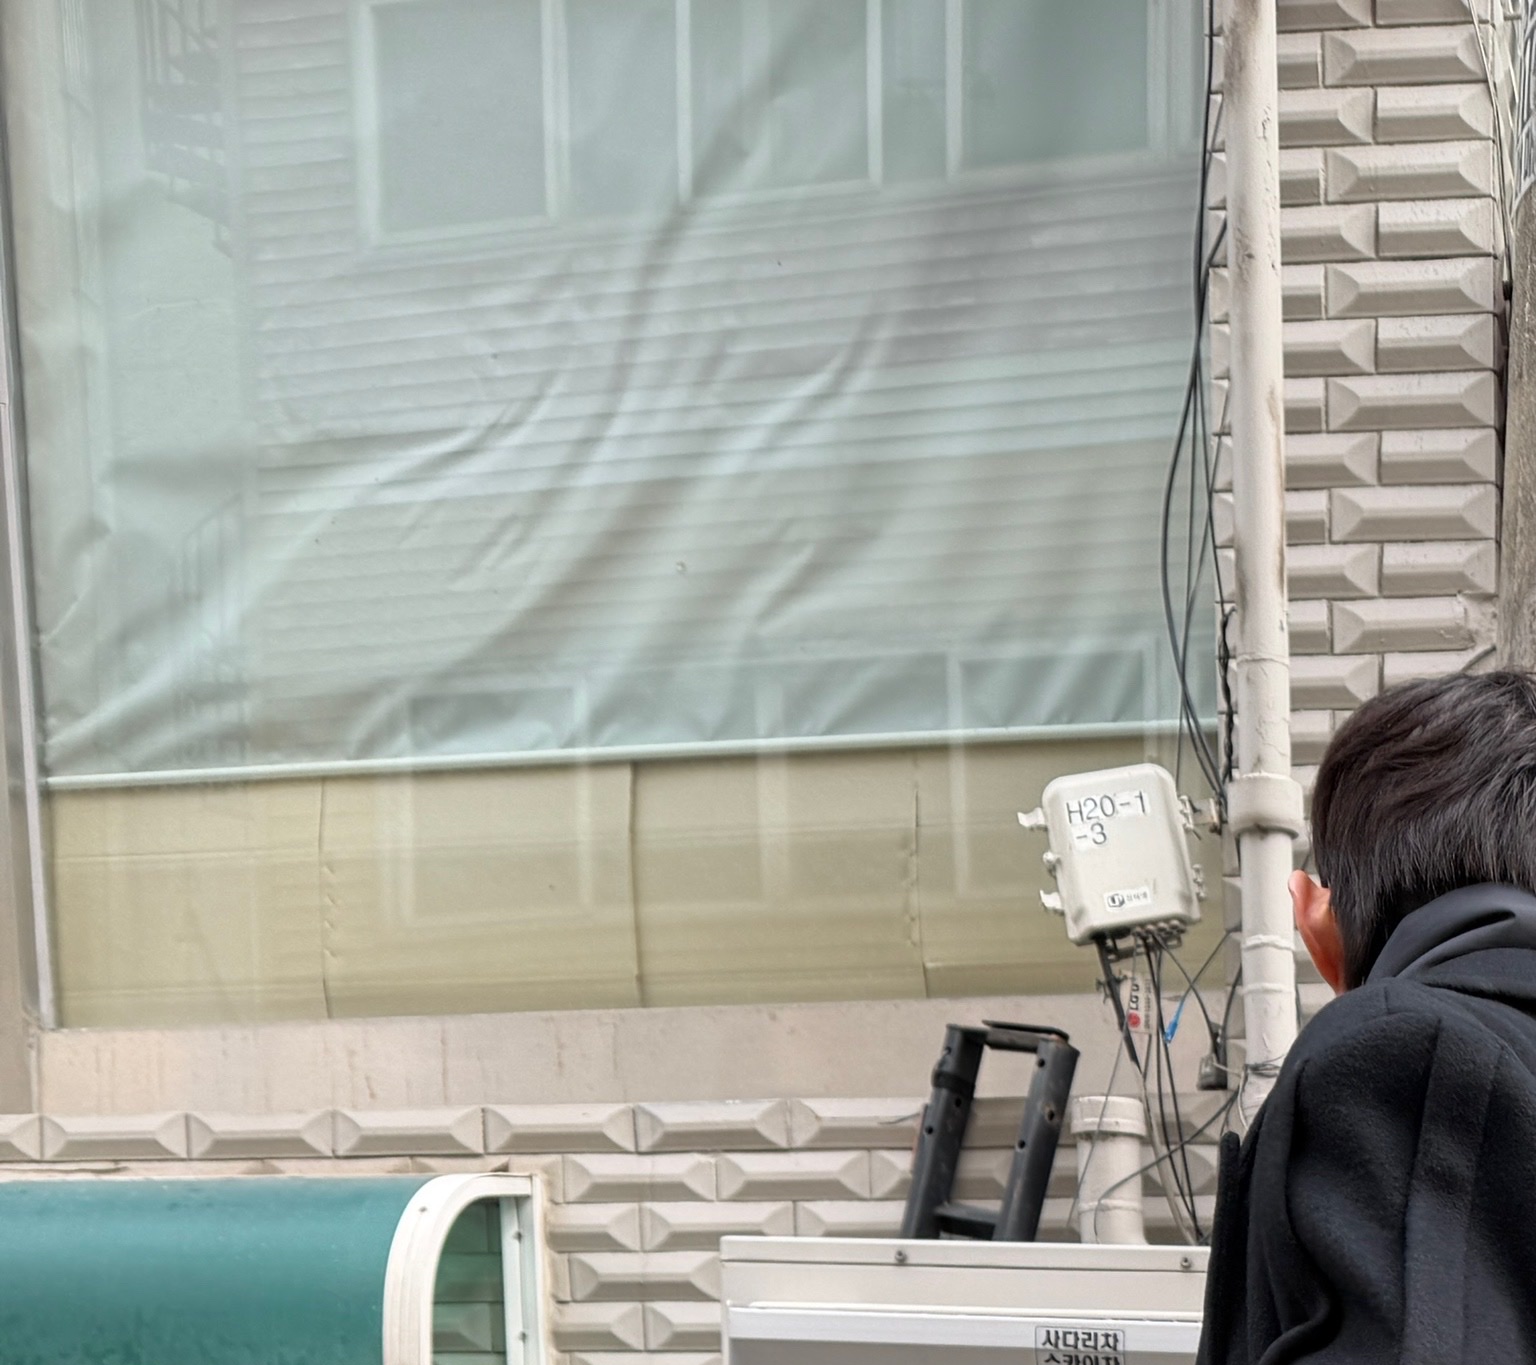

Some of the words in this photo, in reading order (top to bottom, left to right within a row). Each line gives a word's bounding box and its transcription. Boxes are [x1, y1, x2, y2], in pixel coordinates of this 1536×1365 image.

[1065, 789, 1146, 825] H20-1
[1076, 822, 1108, 846] -3
[1041, 1328, 1120, 1352] 사다리차
